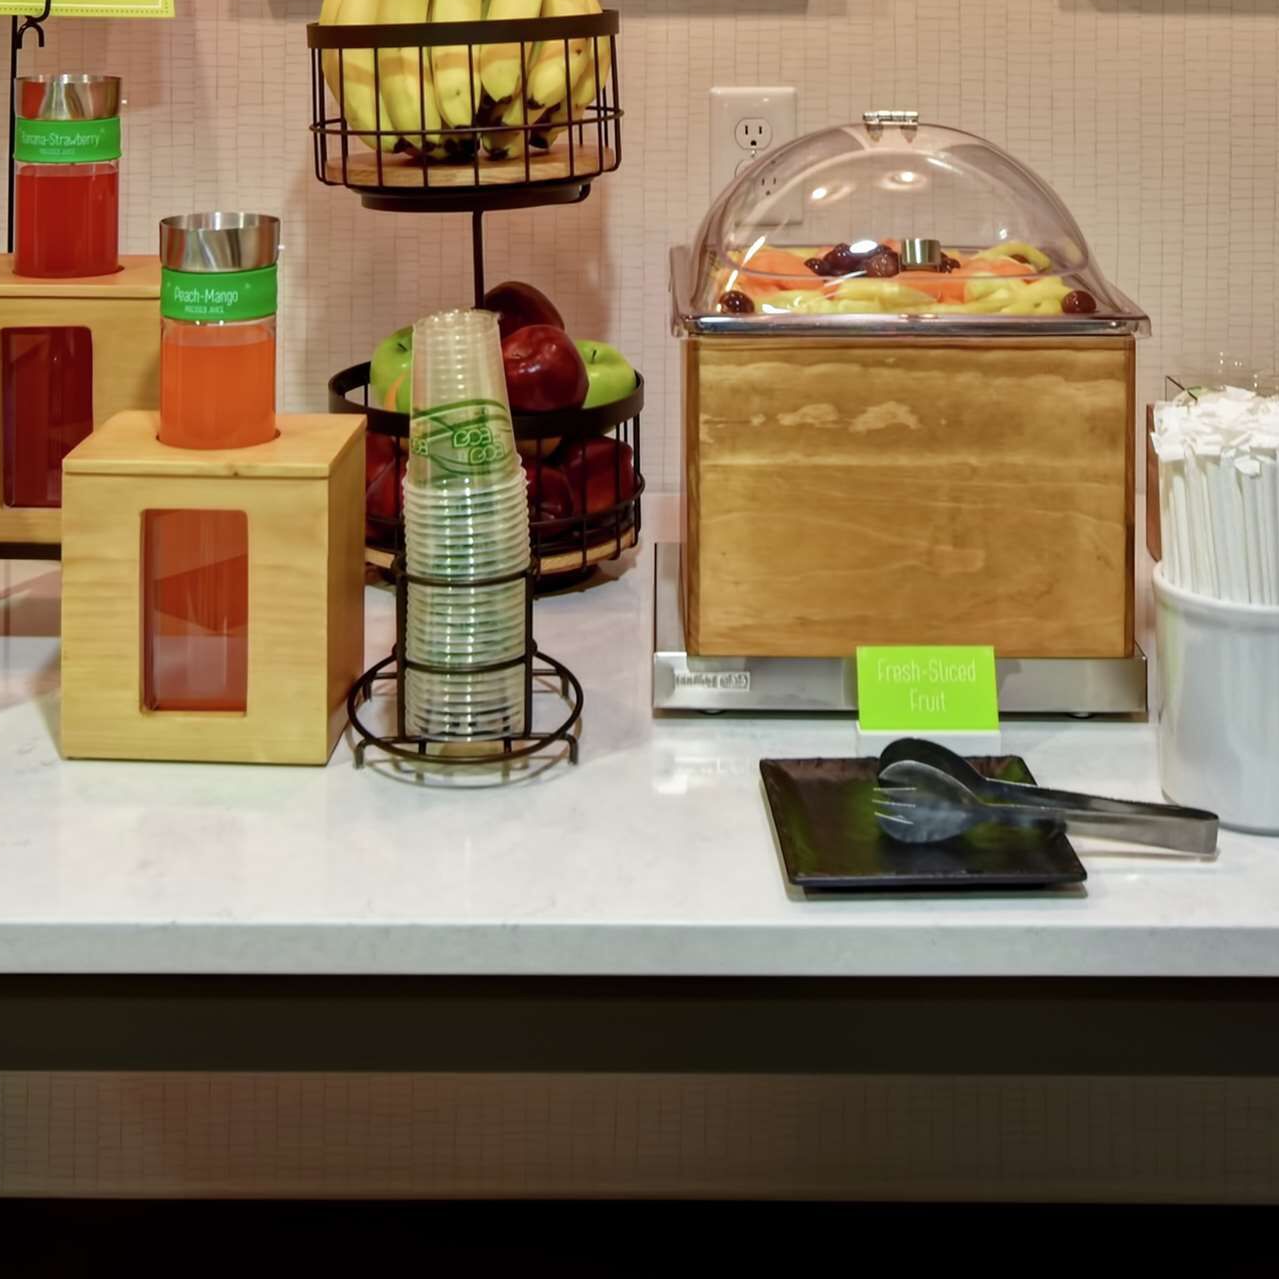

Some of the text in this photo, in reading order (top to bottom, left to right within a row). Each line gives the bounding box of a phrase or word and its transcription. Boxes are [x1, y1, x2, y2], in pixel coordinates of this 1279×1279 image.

[174, 286, 238, 306] Peach-Mango
[877, 658, 977, 682] Fresh-Sliced
[910, 690, 946, 713] Fruit
